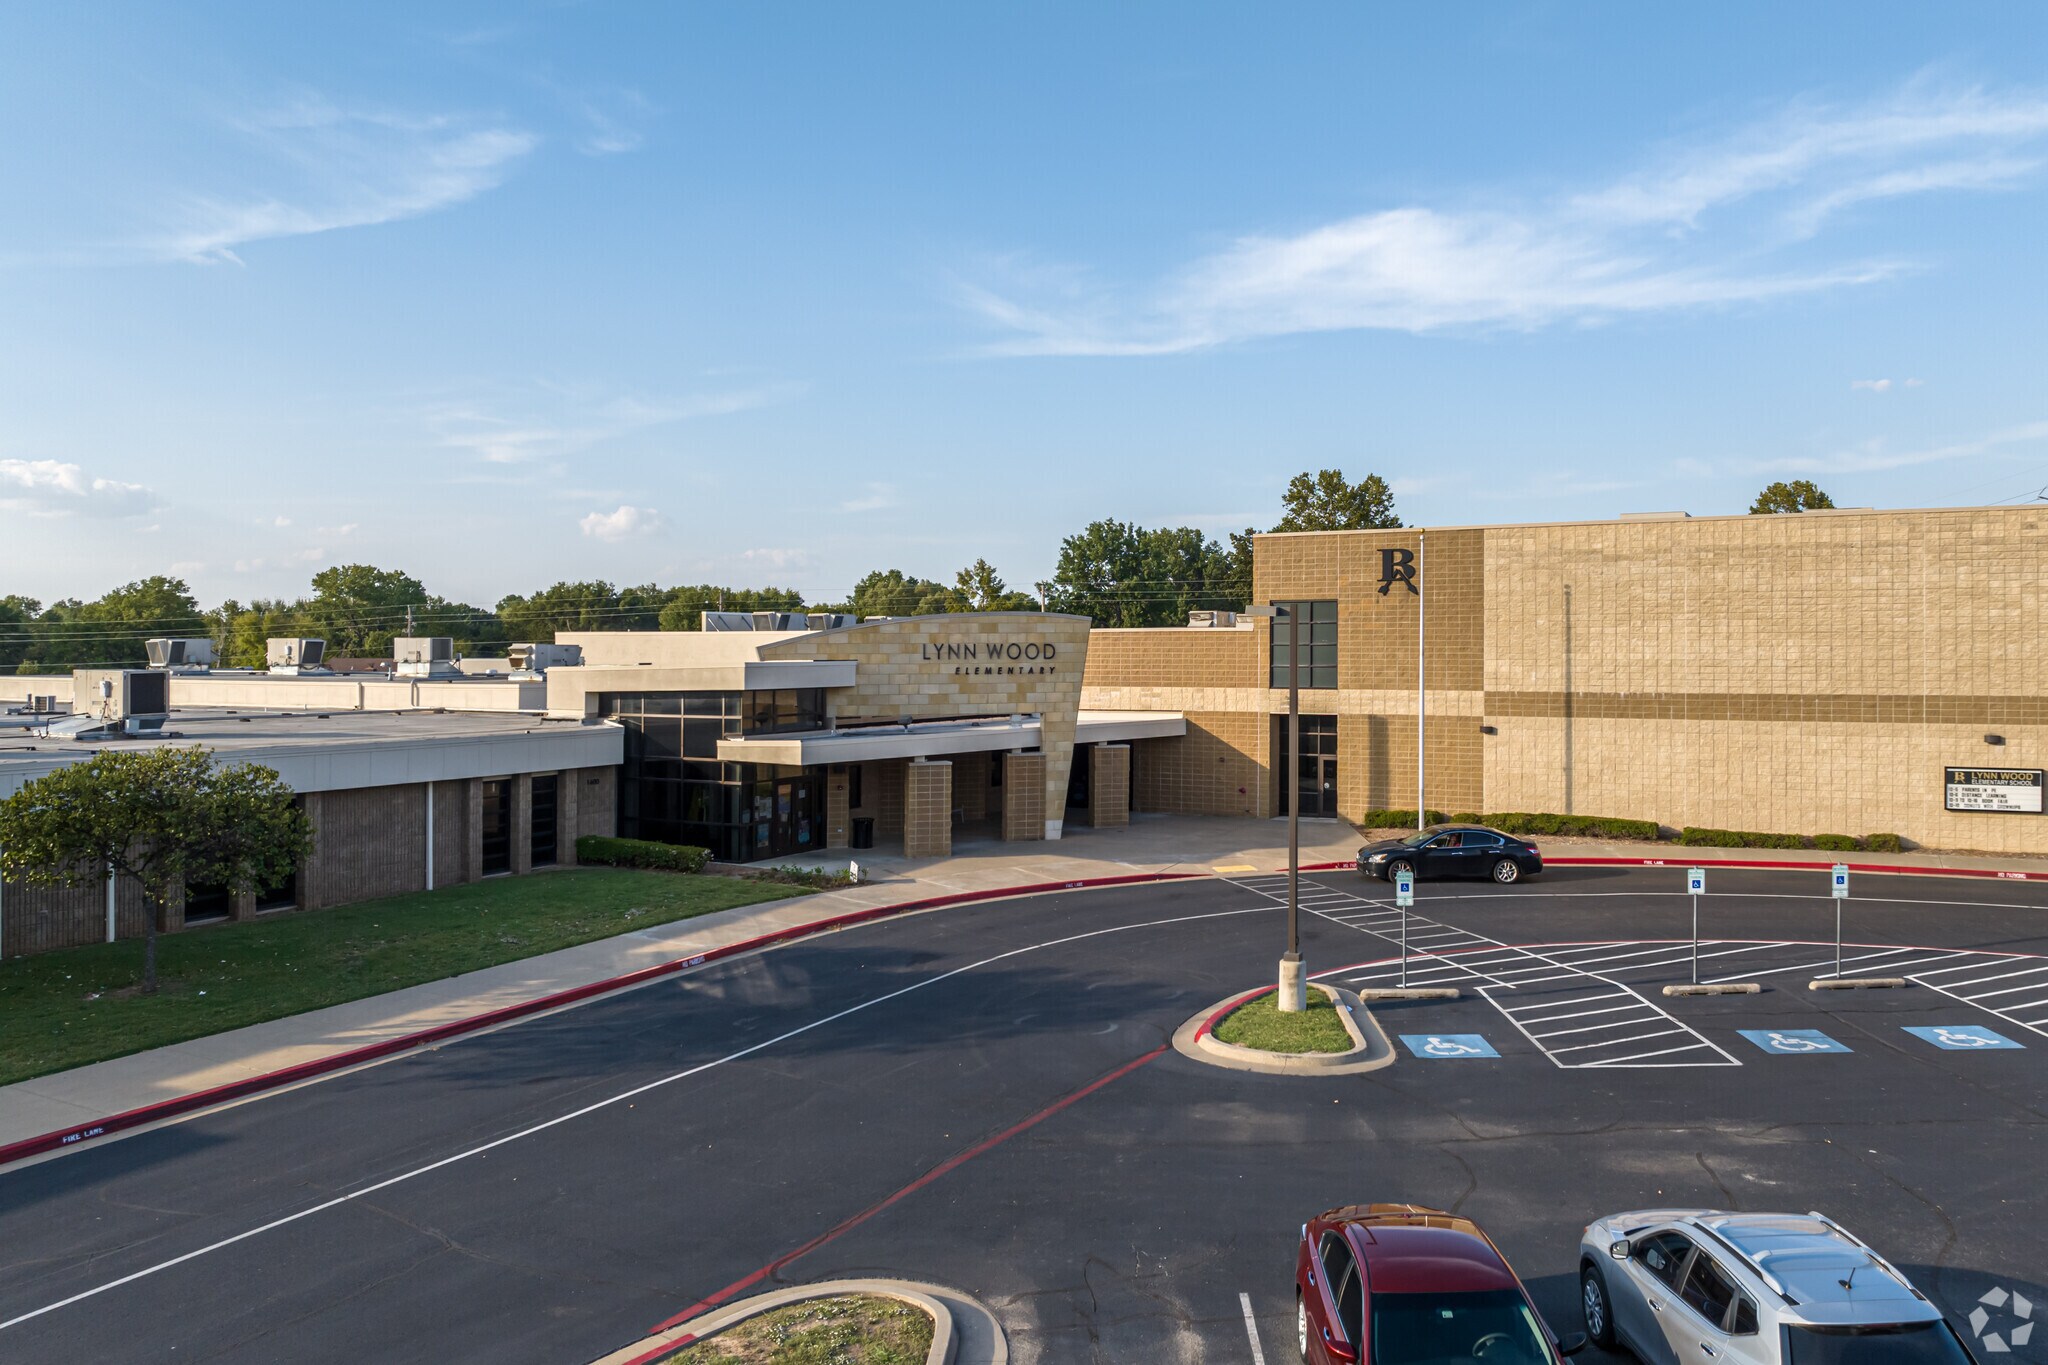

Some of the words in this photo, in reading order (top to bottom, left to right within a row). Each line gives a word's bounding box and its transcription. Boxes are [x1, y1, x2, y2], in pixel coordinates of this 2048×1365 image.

[922, 642, 976, 660] LYNN
[986, 642, 1056, 660] WOOD
[954, 666, 1056, 675] ELEMENTARY
[2000, 772, 2033, 780] WOOD
[63, 1133, 81, 1143] FIRE
[84, 1128, 104, 1137] LANE
